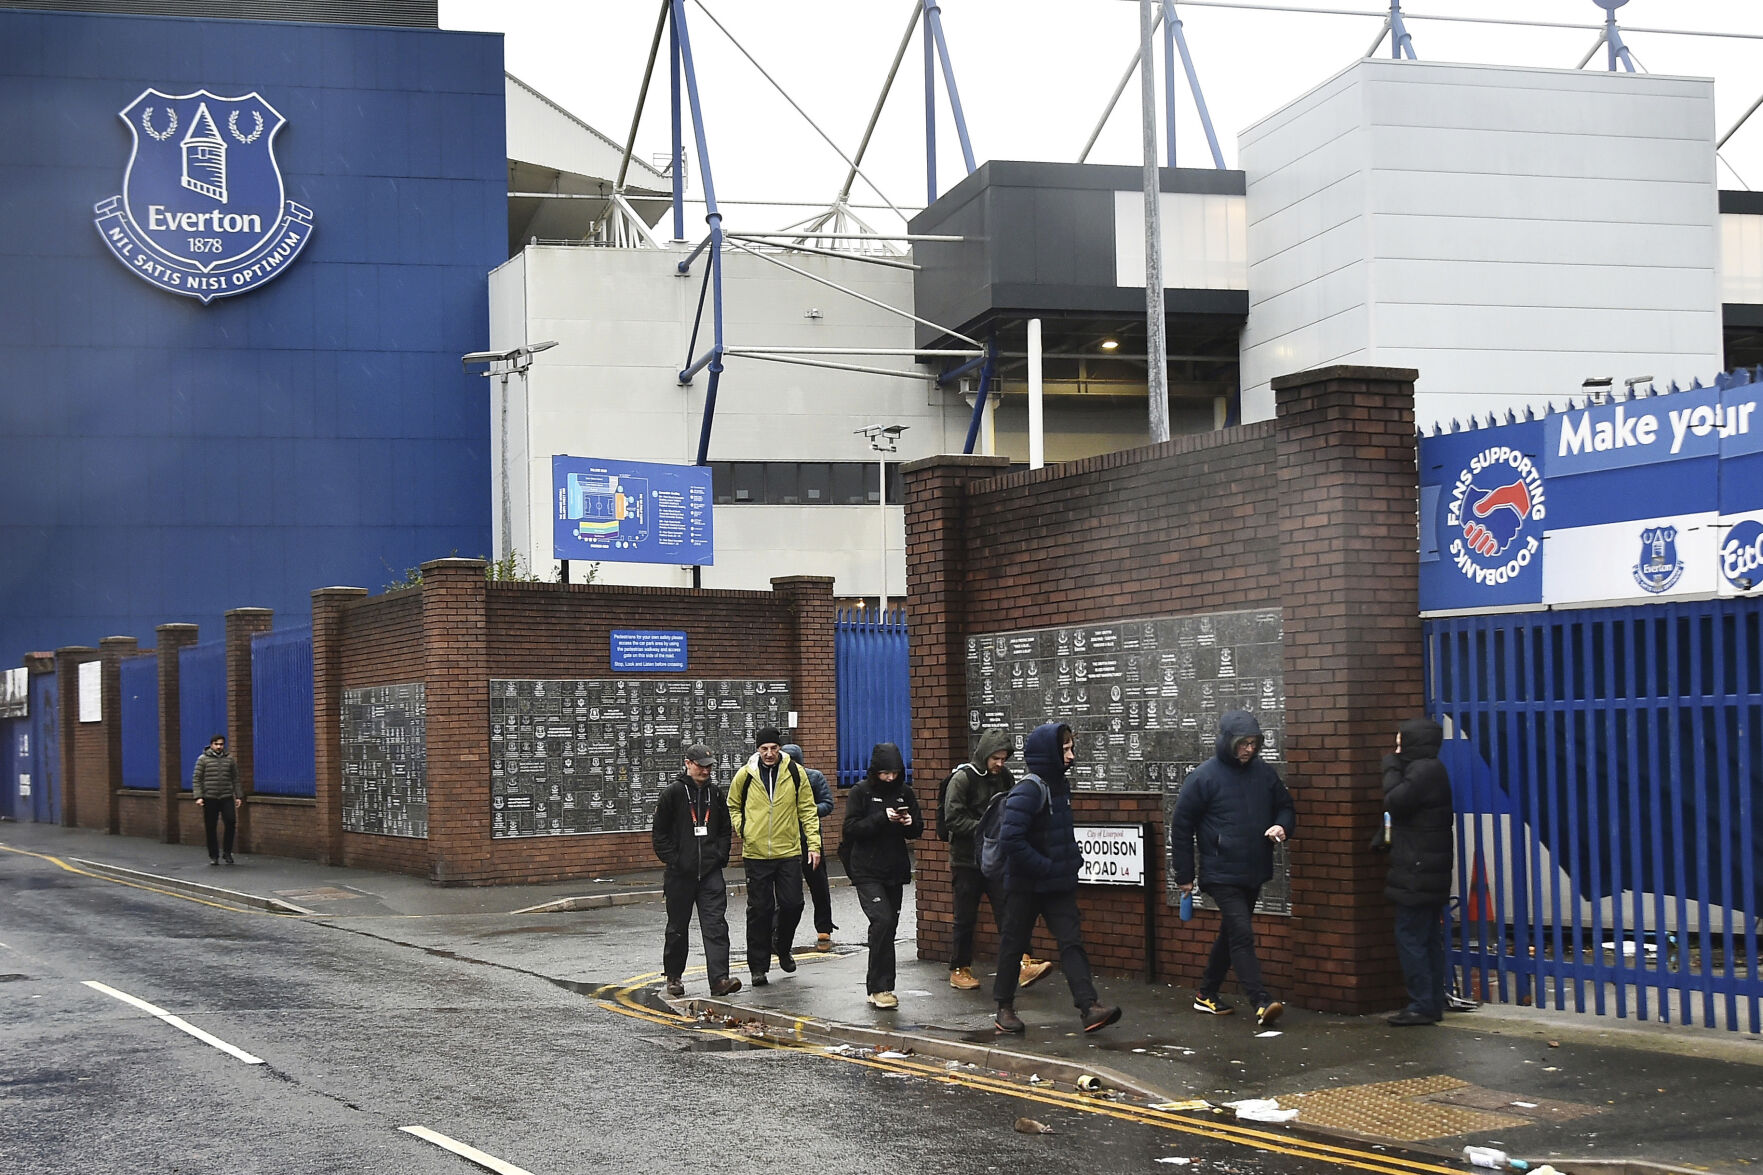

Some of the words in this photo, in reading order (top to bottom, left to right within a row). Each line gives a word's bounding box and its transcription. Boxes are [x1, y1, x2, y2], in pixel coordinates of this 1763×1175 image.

[148, 205, 261, 233] Everton
[108, 226, 132, 256] NIL
[134, 254, 182, 285] SATIS
[186, 276, 228, 289] NISI
[232, 230, 301, 285] OPTIMUM
[187, 238, 222, 253] 1878
[1558, 405, 1659, 457] Make
[1669, 401, 1757, 454] your
[1447, 469, 1473, 527] FANS
[1470, 446, 1546, 521] SUPPORTING
[1449, 536, 1540, 586] FOODBANKS
[1103, 830, 1124, 840] Liverpool
[1086, 861, 1118, 876] ROAD
